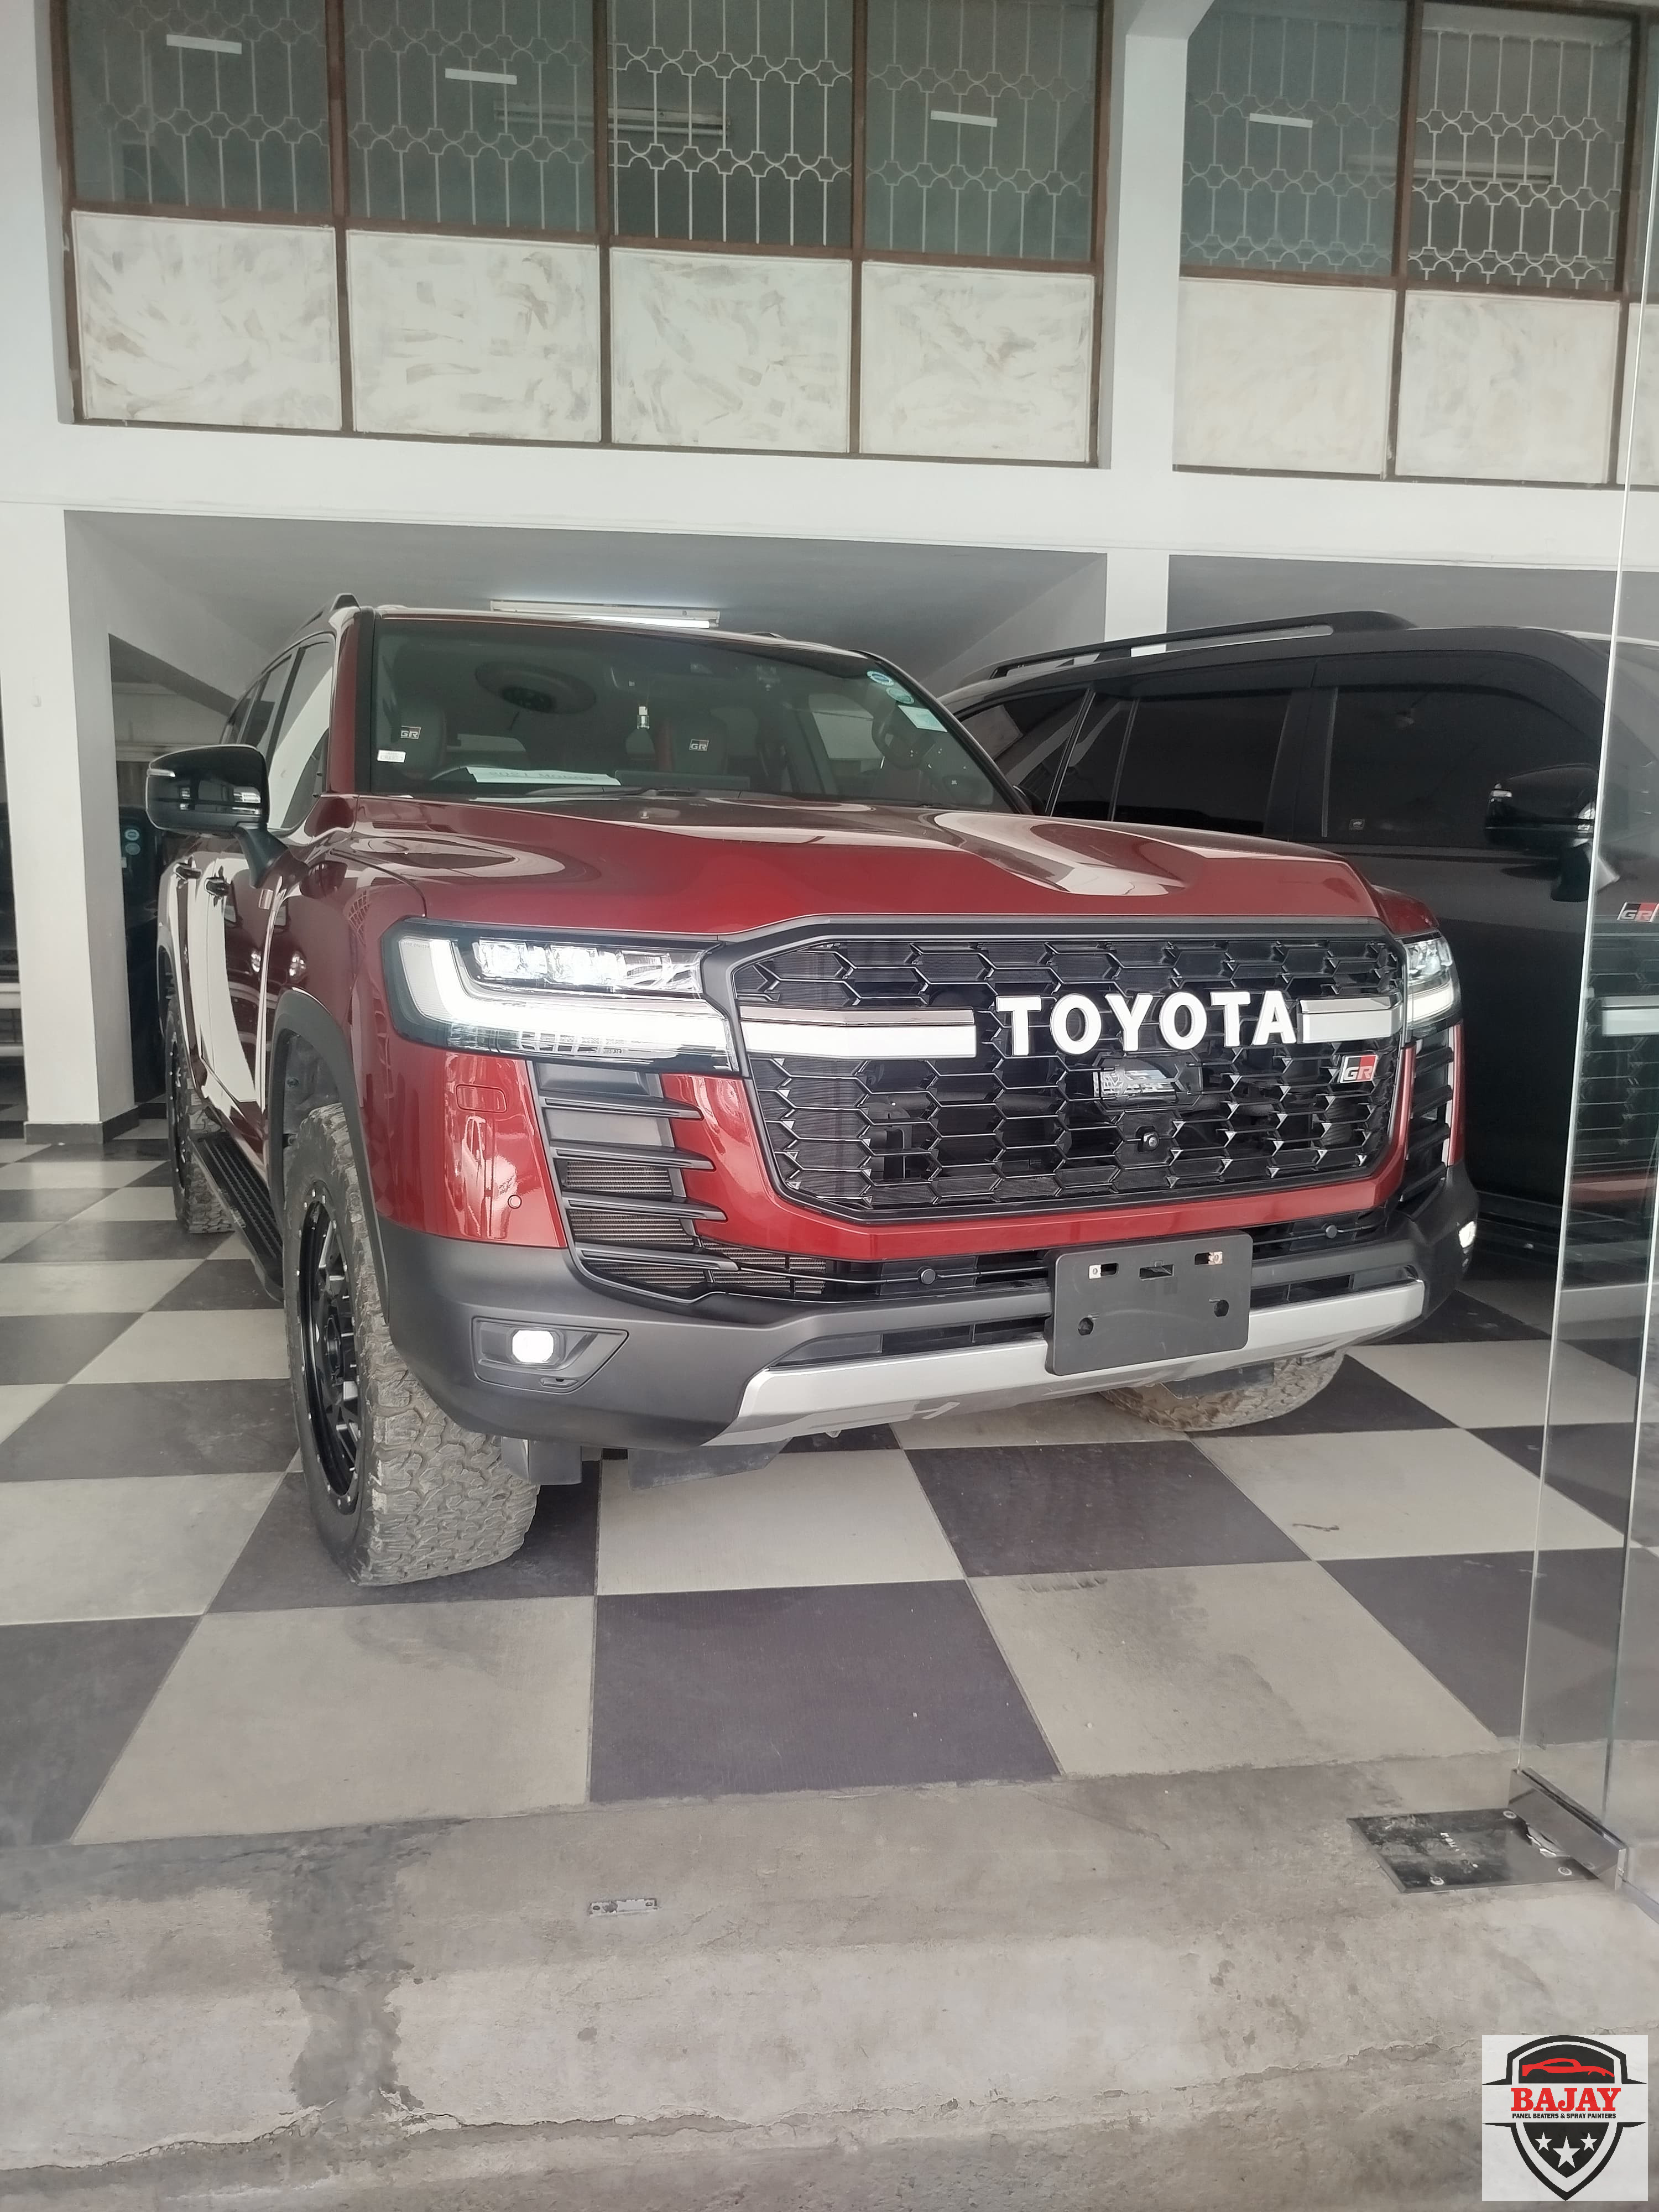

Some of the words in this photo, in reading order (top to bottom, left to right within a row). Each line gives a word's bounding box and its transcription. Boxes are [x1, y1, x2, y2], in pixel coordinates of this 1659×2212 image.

[401, 730, 418, 738] GR
[1621, 910, 1653, 921] GR
[995, 990, 1297, 1056] TOYOTA
[1343, 1066, 1373, 1081] GR
